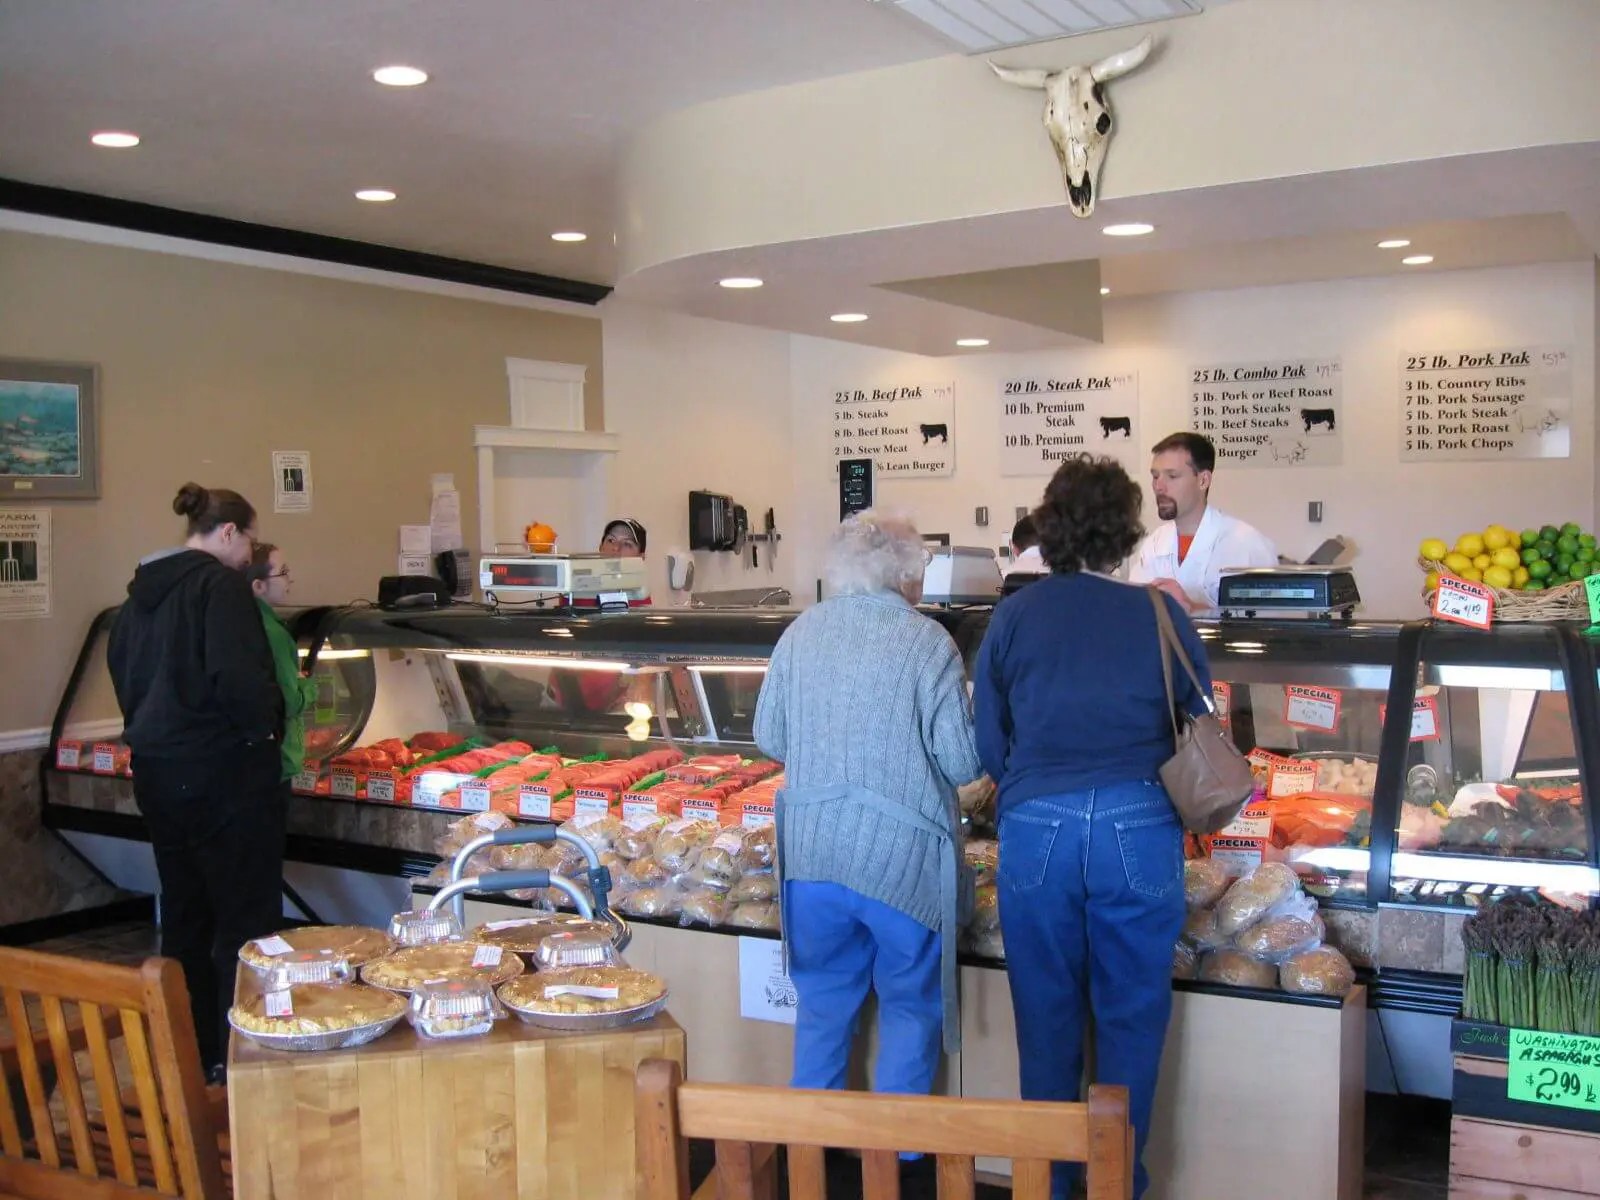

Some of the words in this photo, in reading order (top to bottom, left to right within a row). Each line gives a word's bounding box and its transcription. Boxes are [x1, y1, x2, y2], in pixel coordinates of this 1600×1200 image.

[1406, 356, 1426, 370] 25
[1432, 355, 1452, 368] lb.
[1458, 353, 1494, 367] Pork
[1500, 351, 1530, 365] Pak
[1193, 370, 1209, 382] 25
[1214, 369, 1229, 381] lb.
[1234, 366, 1278, 380] Combo
[1282, 364, 1306, 378] Pak
[1005, 382, 1021, 394] 20
[1025, 381, 1042, 392] lb.
[1046, 378, 1083, 391] Steak
[1087, 376, 1112, 389] Pak
[1406, 380, 1412, 391] 3
[1417, 380, 1433, 390] lb.
[1437, 378, 1492, 391] Country
[1495, 376, 1526, 387] Ribs
[835, 392, 849, 402] 25
[853, 390, 868, 401] lb.
[872, 389, 897, 402] Beef
[900, 386, 922, 399] Pak
[1192, 392, 1199, 402] 5
[1203, 392, 1218, 402] lb.
[1222, 390, 1248, 401] Pork
[1252, 392, 1264, 400] or
[1268, 388, 1294, 399] Beef
[1298, 387, 1333, 398] Roast
[1406, 396, 1412, 406] 7
[1417, 395, 1433, 405] lb.
[1438, 394, 1468, 404] Pork
[1471, 392, 1525, 405] Sausage
[1005, 404, 1017, 415] 10
[1020, 402, 1033, 414] lb.
[1037, 400, 1085, 414] Premium
[1192, 406, 1199, 416] 5
[1203, 406, 1218, 416] lb.
[1222, 404, 1248, 416] Pork
[1252, 403, 1291, 414] Steaks
[1406, 411, 1412, 421] 5
[1417, 410, 1433, 420] lb.
[1438, 408, 1468, 419] Pork
[1471, 407, 1508, 418] Steak
[834, 412, 840, 420] 5
[842, 411, 854, 420] lb.
[857, 410, 888, 419] Steaks
[1046, 415, 1076, 428] Steak
[1192, 420, 1199, 430] 5
[1203, 420, 1218, 430] lb.
[1222, 419, 1248, 429] Beef
[1250, 417, 1289, 428] Steaks
[1406, 425, 1412, 435] 5
[1417, 424, 1433, 435] lb.
[1438, 424, 1468, 434] Pork
[1471, 423, 1510, 434] Roast
[834, 430, 840, 438] 8
[842, 428, 855, 438] lb.
[858, 427, 879, 437] Beef
[881, 426, 908, 436] Roast
[1005, 435, 1017, 447] 10
[1020, 434, 1033, 446] lb.
[1036, 433, 1084, 446] Premium
[1222, 434, 1269, 445] Sausage
[1406, 440, 1412, 450] 5
[1417, 440, 1433, 450] lb.
[1438, 439, 1468, 450] Pork
[1471, 438, 1514, 451] Chops
[834, 447, 840, 456] 2
[843, 446, 855, 455] lb.
[858, 445, 881, 454] Stew
[883, 444, 908, 454] Meat
[1042, 448, 1078, 463] Burger
[1218, 448, 1258, 460] Burger
[886, 462, 910, 471] Lean
[912, 461, 945, 472] Burger
[1441, 578, 1484, 596] SPECIAL
[1290, 686, 1333, 700] SPECIAL
[1275, 764, 1313, 772] SPECIAL
[520, 784, 548, 793] SPECIAL
[576, 789, 606, 798] SPECIAL
[624, 794, 654, 802] SPECIAL
[682, 799, 714, 808] SPECIAL
[1212, 839, 1258, 848] SPECIAL
[1516, 1032, 1600, 1051] WASHINGTON
[1519, 1048, 1600, 1067] ASPARAGUS
